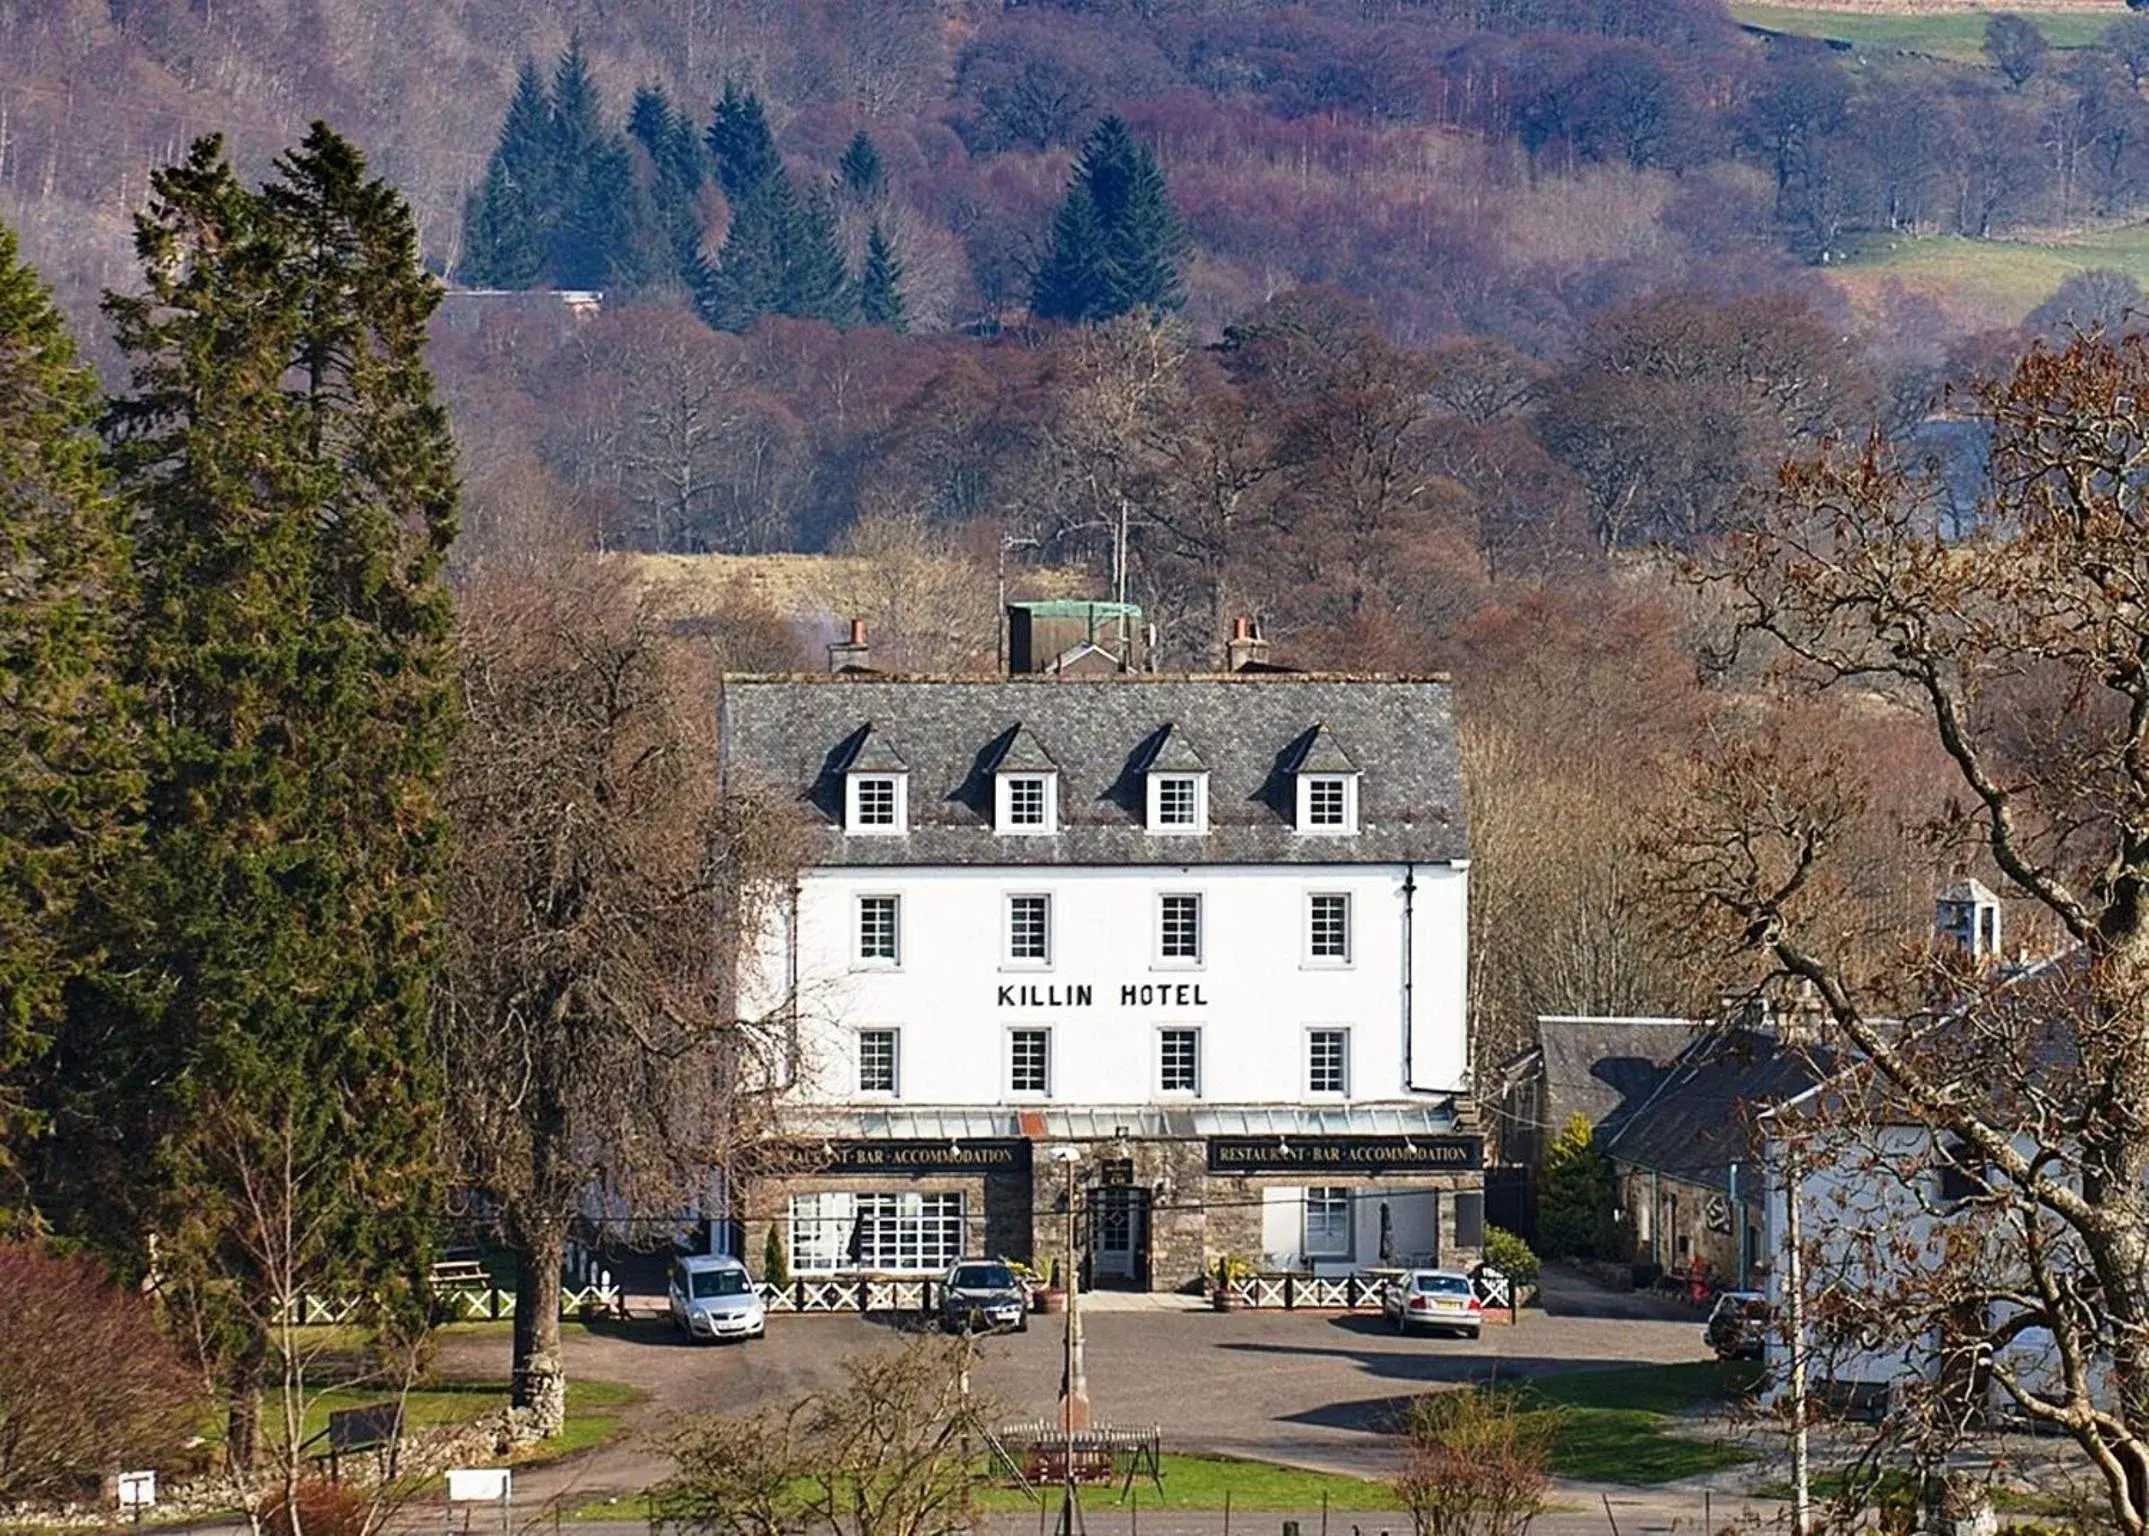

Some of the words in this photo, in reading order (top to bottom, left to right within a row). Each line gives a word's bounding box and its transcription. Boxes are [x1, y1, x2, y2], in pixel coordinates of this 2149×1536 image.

[998, 984, 1092, 1006] KILLIN
[1121, 984, 1208, 1006] HOTEL
[856, 1149, 883, 1164] BAR
[893, 1148, 1013, 1164] ACCOMMODATION
[1313, 1147, 1340, 1161] BAR
[1348, 1147, 1468, 1161] ACCOMMODATION
